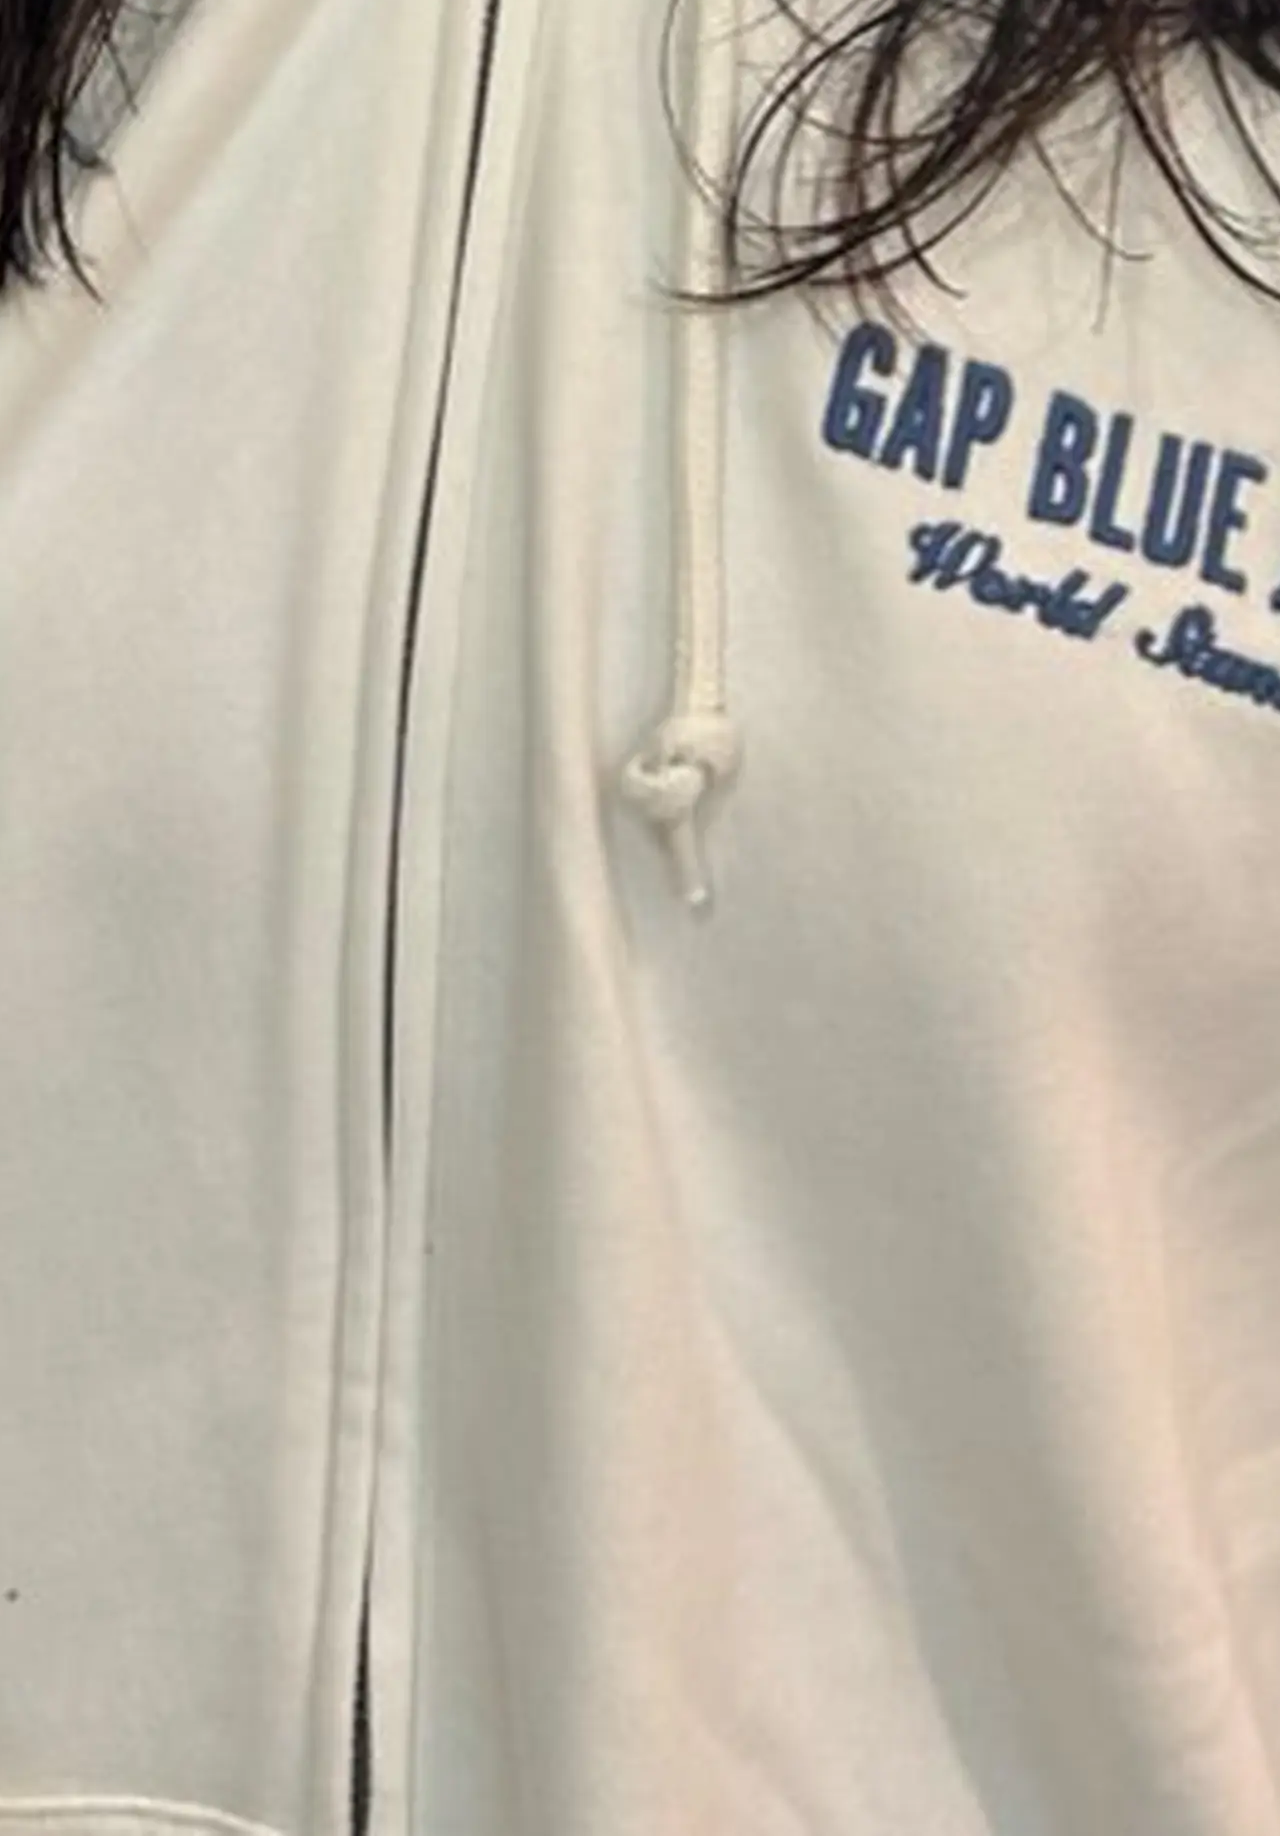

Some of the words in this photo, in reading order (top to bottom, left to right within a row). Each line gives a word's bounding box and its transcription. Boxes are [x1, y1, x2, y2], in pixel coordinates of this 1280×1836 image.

[821, 322, 1014, 489] GAP
[1027, 390, 1267, 592] BLUE
[908, 522, 1130, 640] World
